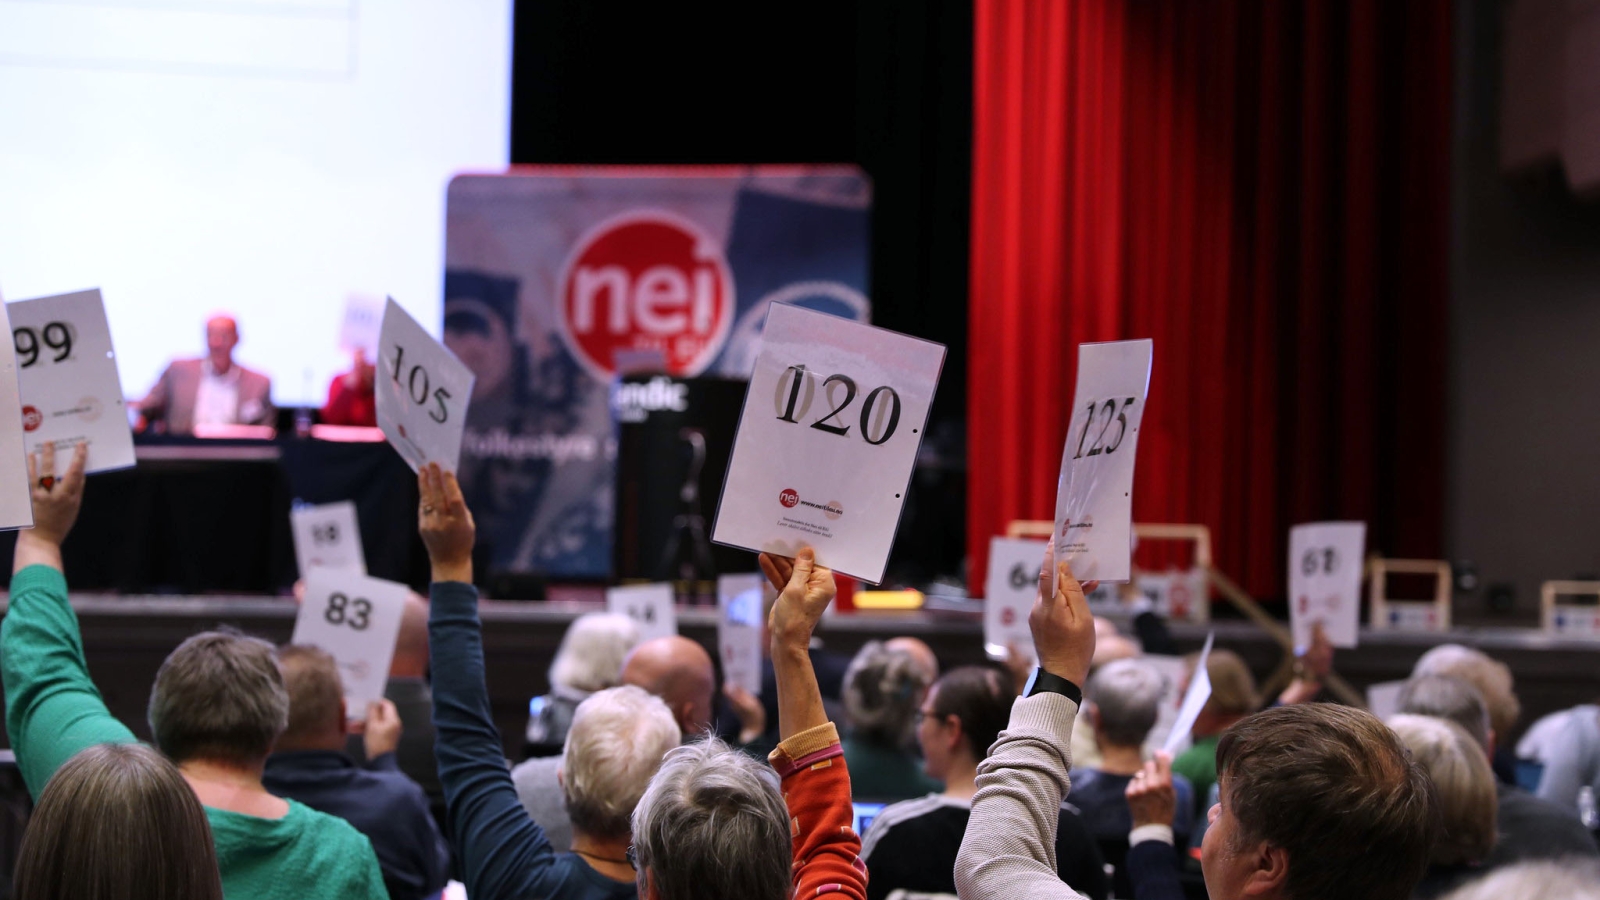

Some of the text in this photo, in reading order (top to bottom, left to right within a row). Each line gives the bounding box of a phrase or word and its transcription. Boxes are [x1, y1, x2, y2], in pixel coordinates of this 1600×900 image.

[572, 239, 721, 333] nei
[14, 320, 72, 370] 99
[394, 343, 452, 424] 105
[776, 364, 902, 445] 120
[1073, 397, 1136, 460] 125
[780, 491, 799, 504] nei
[324, 592, 372, 631] 83
